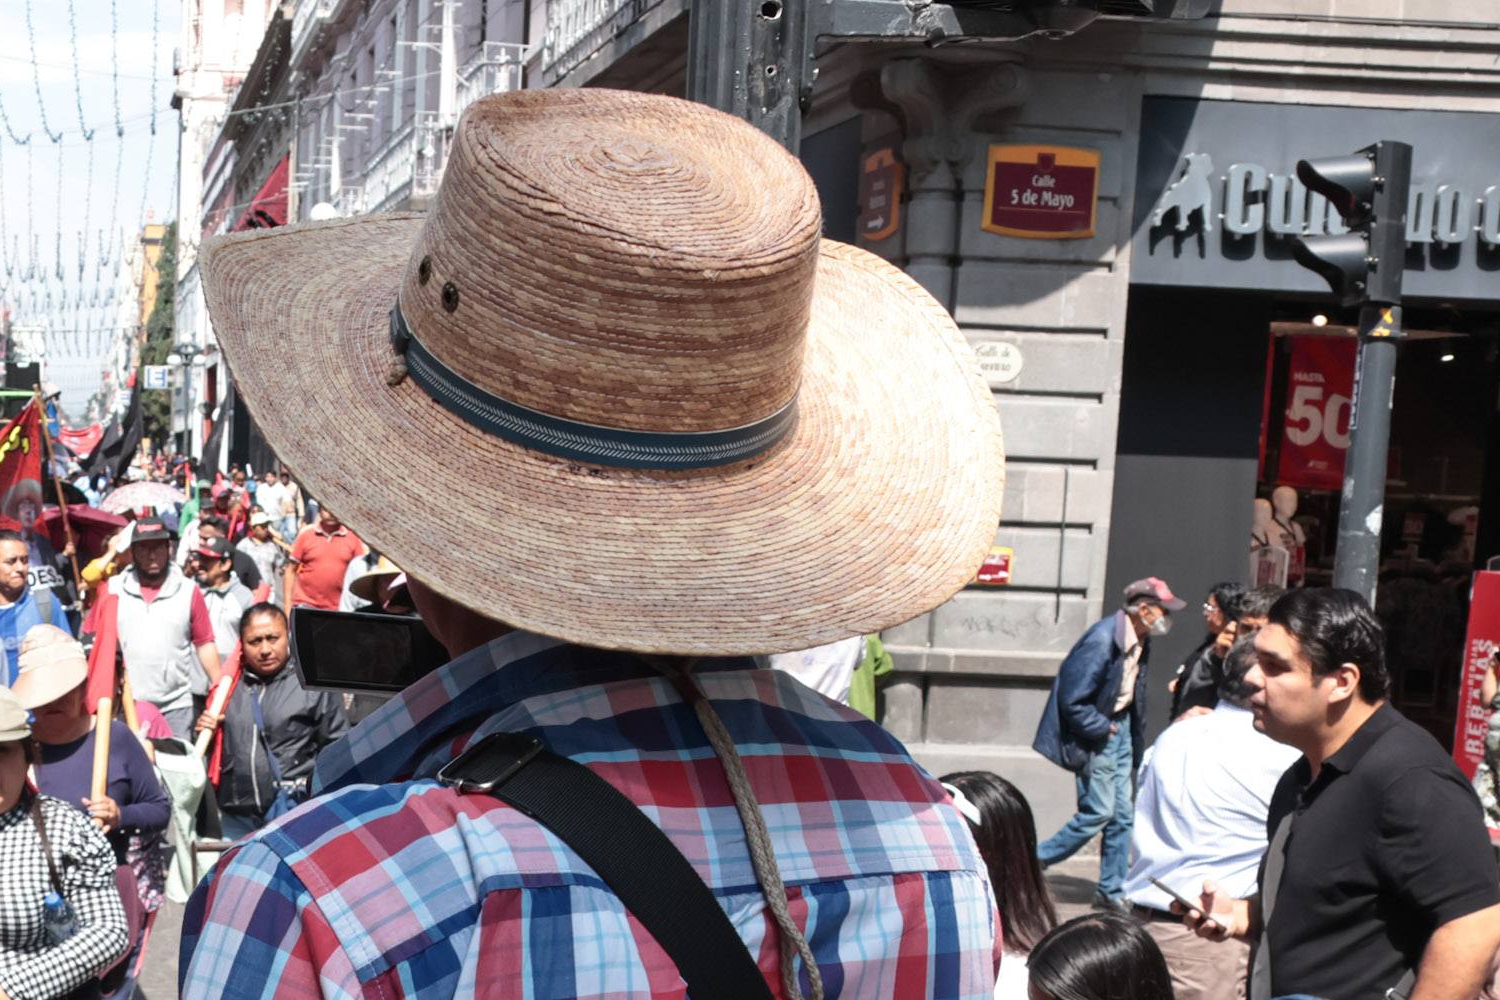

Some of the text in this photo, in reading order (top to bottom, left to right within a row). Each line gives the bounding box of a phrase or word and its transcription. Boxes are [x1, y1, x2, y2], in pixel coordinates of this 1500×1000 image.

[1032, 175, 1056, 188] Calle
[1011, 189, 1074, 210] 5 de Mayo
[1293, 372, 1325, 383] HASTA
[1285, 385, 1351, 448] 50
